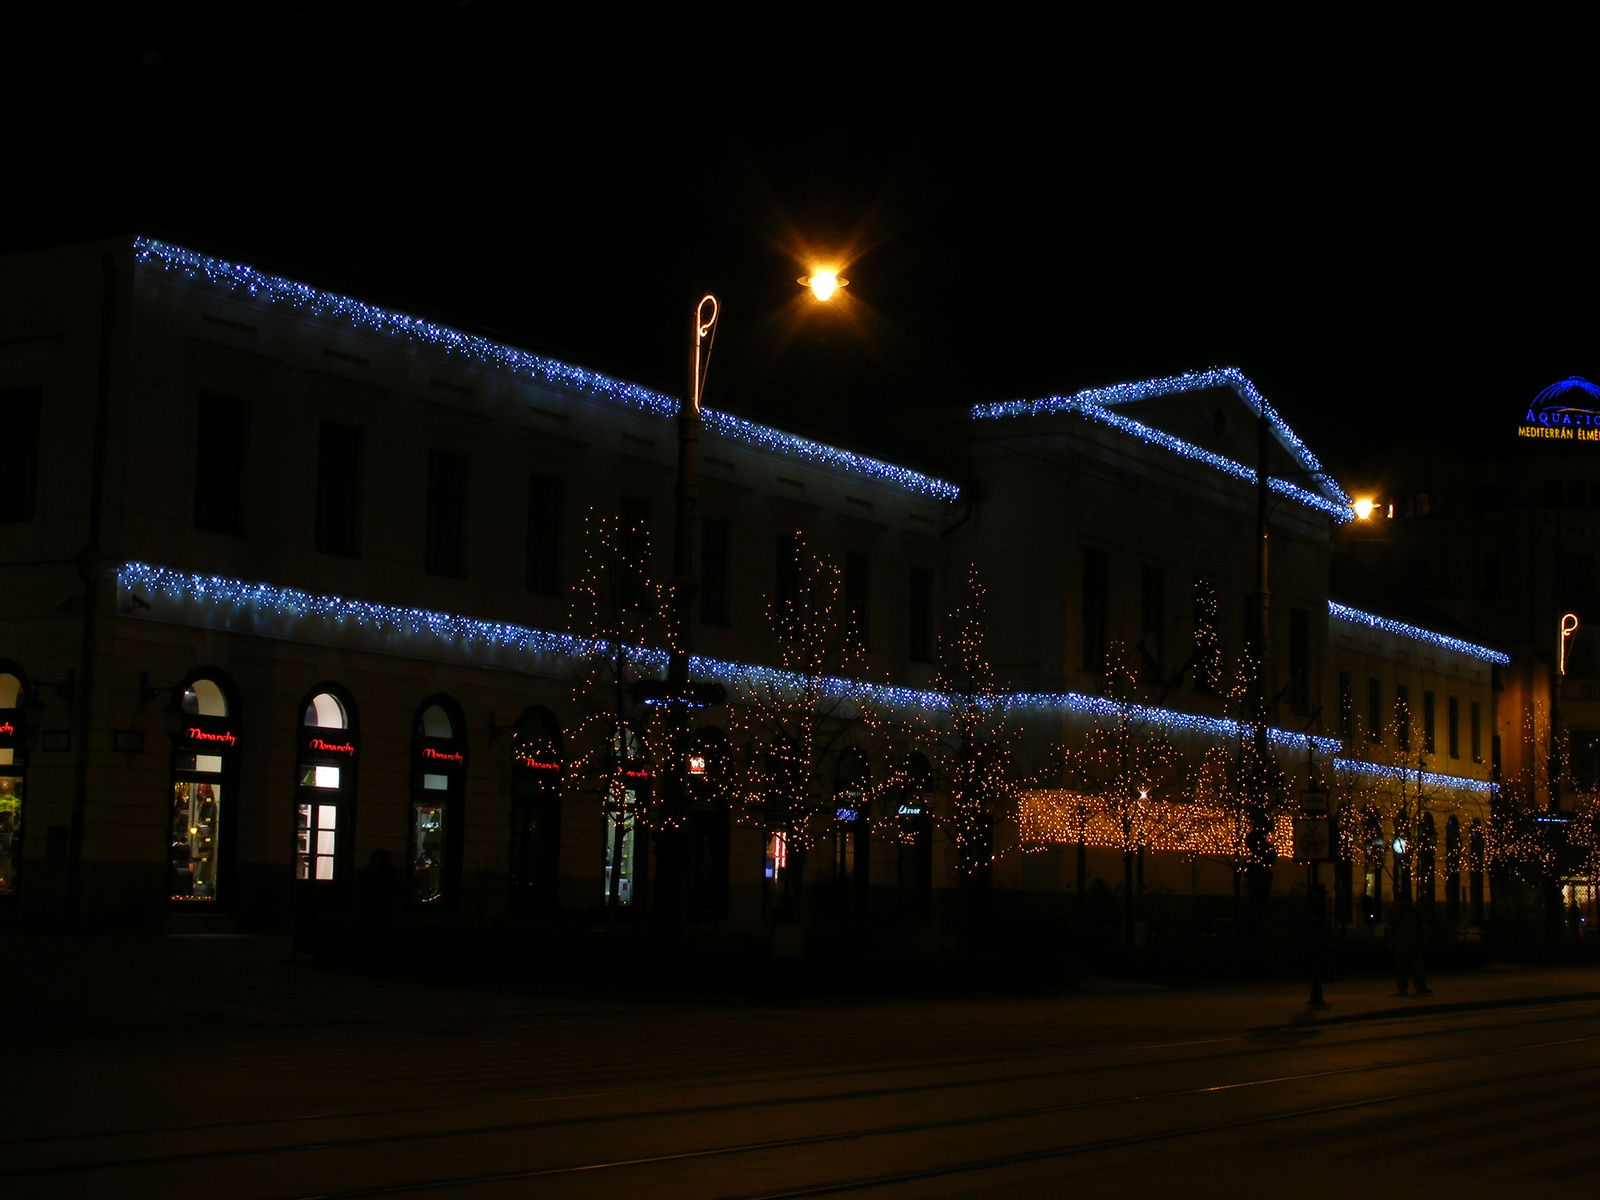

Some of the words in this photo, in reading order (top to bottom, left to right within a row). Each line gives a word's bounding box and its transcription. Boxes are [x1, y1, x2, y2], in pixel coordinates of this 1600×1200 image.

[1526, 408, 1600, 427] AQUATIC
[1518, 426, 1574, 439] MEDITERRÁN
[1577, 427, 1600, 441] ÉLMÉ
[185, 727, 238, 747] Monarchy
[309, 738, 355, 757] Monarchy
[421, 747, 463, 766] Monarchy
